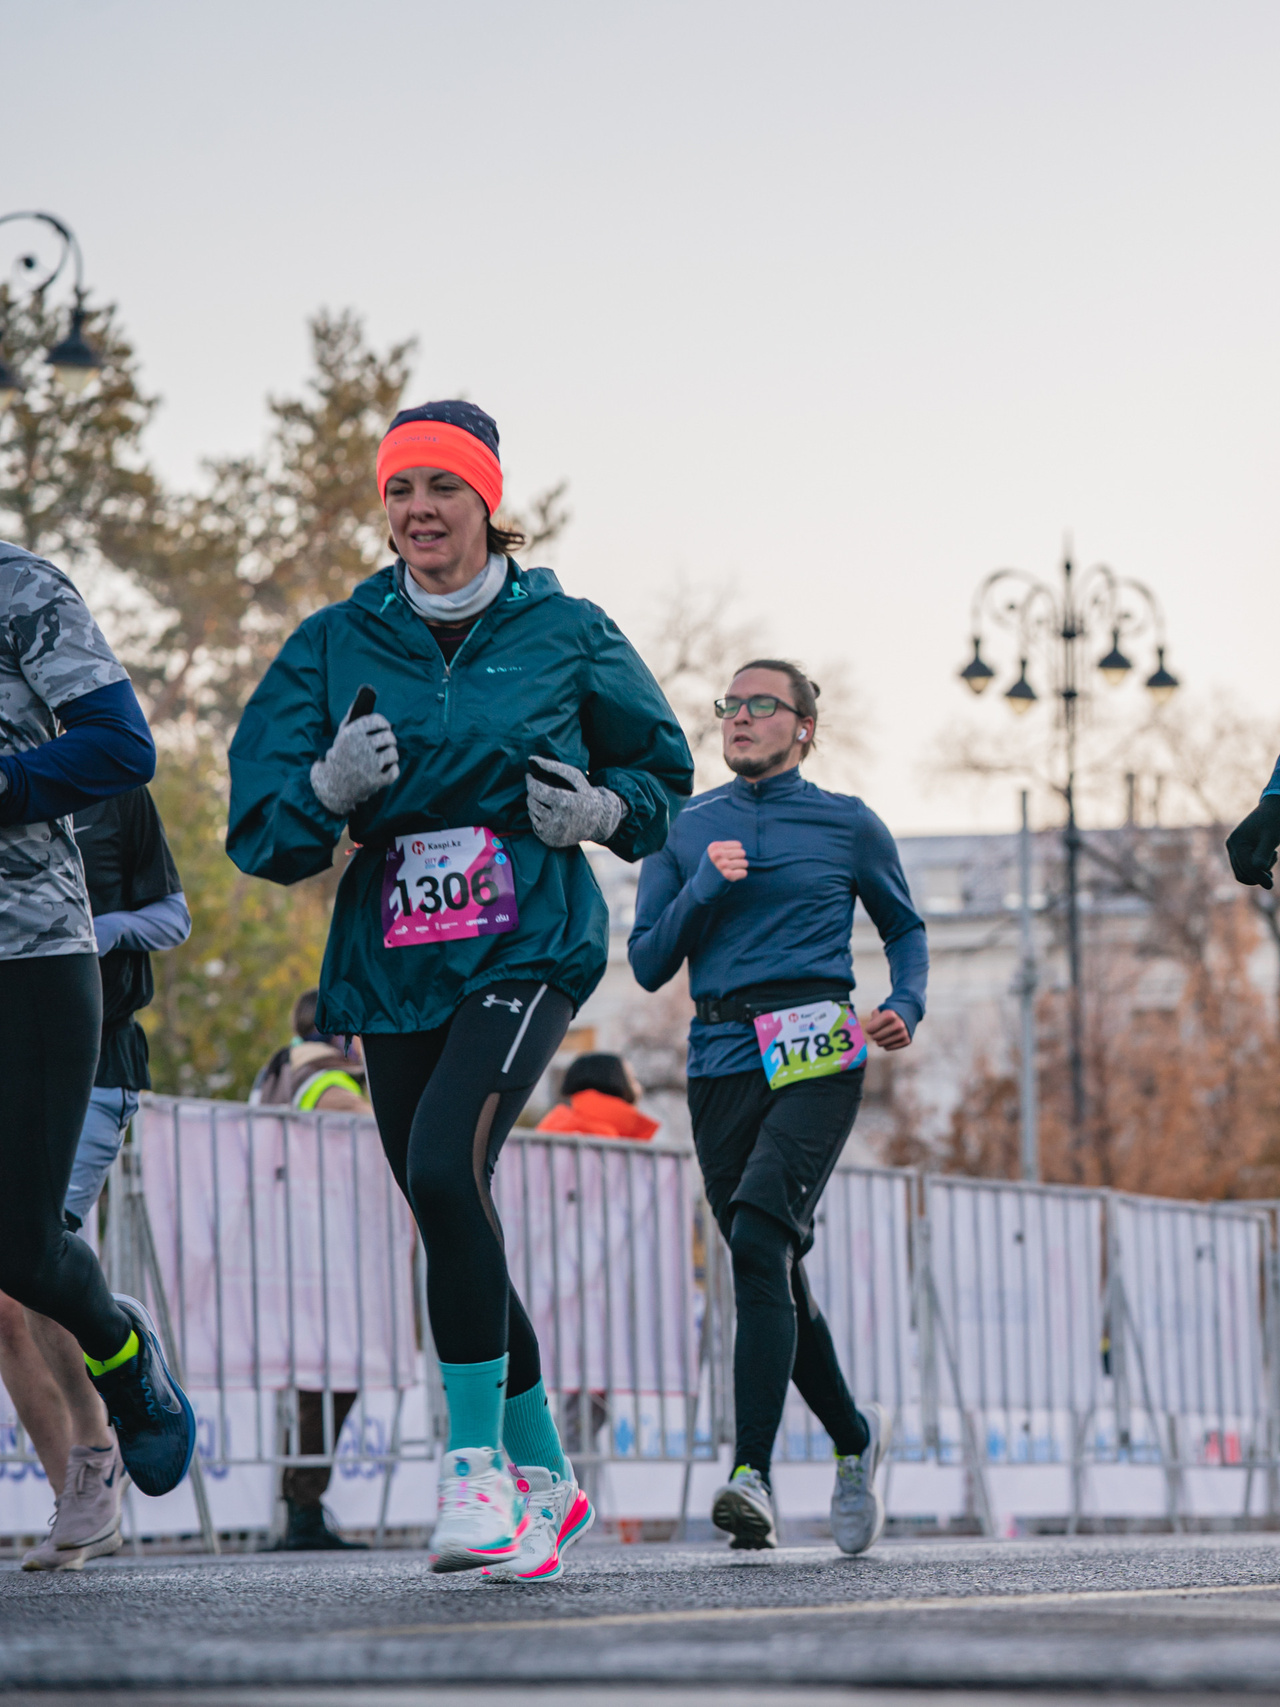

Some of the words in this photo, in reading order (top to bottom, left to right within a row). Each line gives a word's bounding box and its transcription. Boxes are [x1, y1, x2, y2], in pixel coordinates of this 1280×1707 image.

[428, 840, 461, 850] Kaspi.kz
[393, 867, 499, 916] 1306
[774, 1029, 854, 1066] 1783
